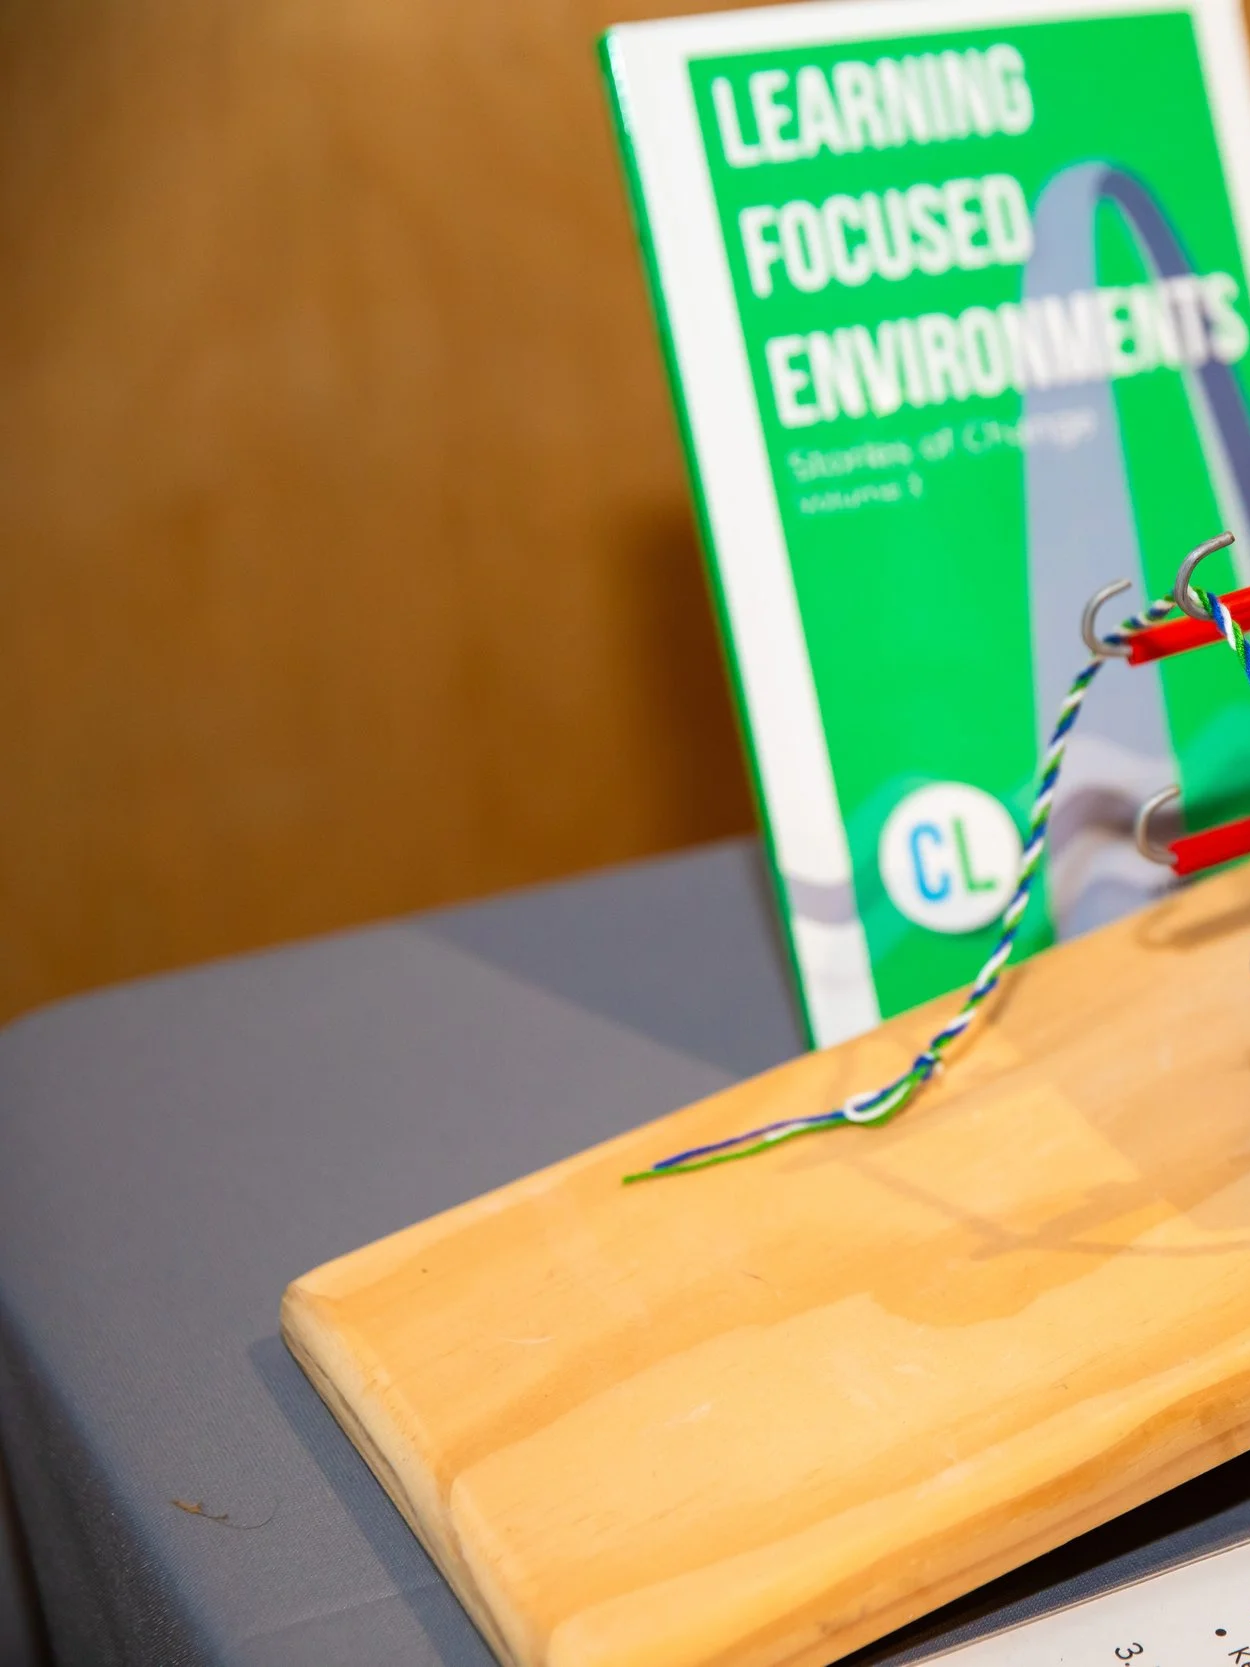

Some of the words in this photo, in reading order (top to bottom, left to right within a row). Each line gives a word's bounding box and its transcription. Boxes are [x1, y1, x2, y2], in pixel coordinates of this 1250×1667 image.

[712, 44, 1034, 167] LEARNING
[739, 174, 1034, 298] FOCUSED
[765, 272, 1249, 428] ENVIRONMENTS
[787, 441, 913, 482] Stories
[919, 427, 954, 461] of
[962, 408, 1095, 453] Change
[910, 817, 996, 902] CL
